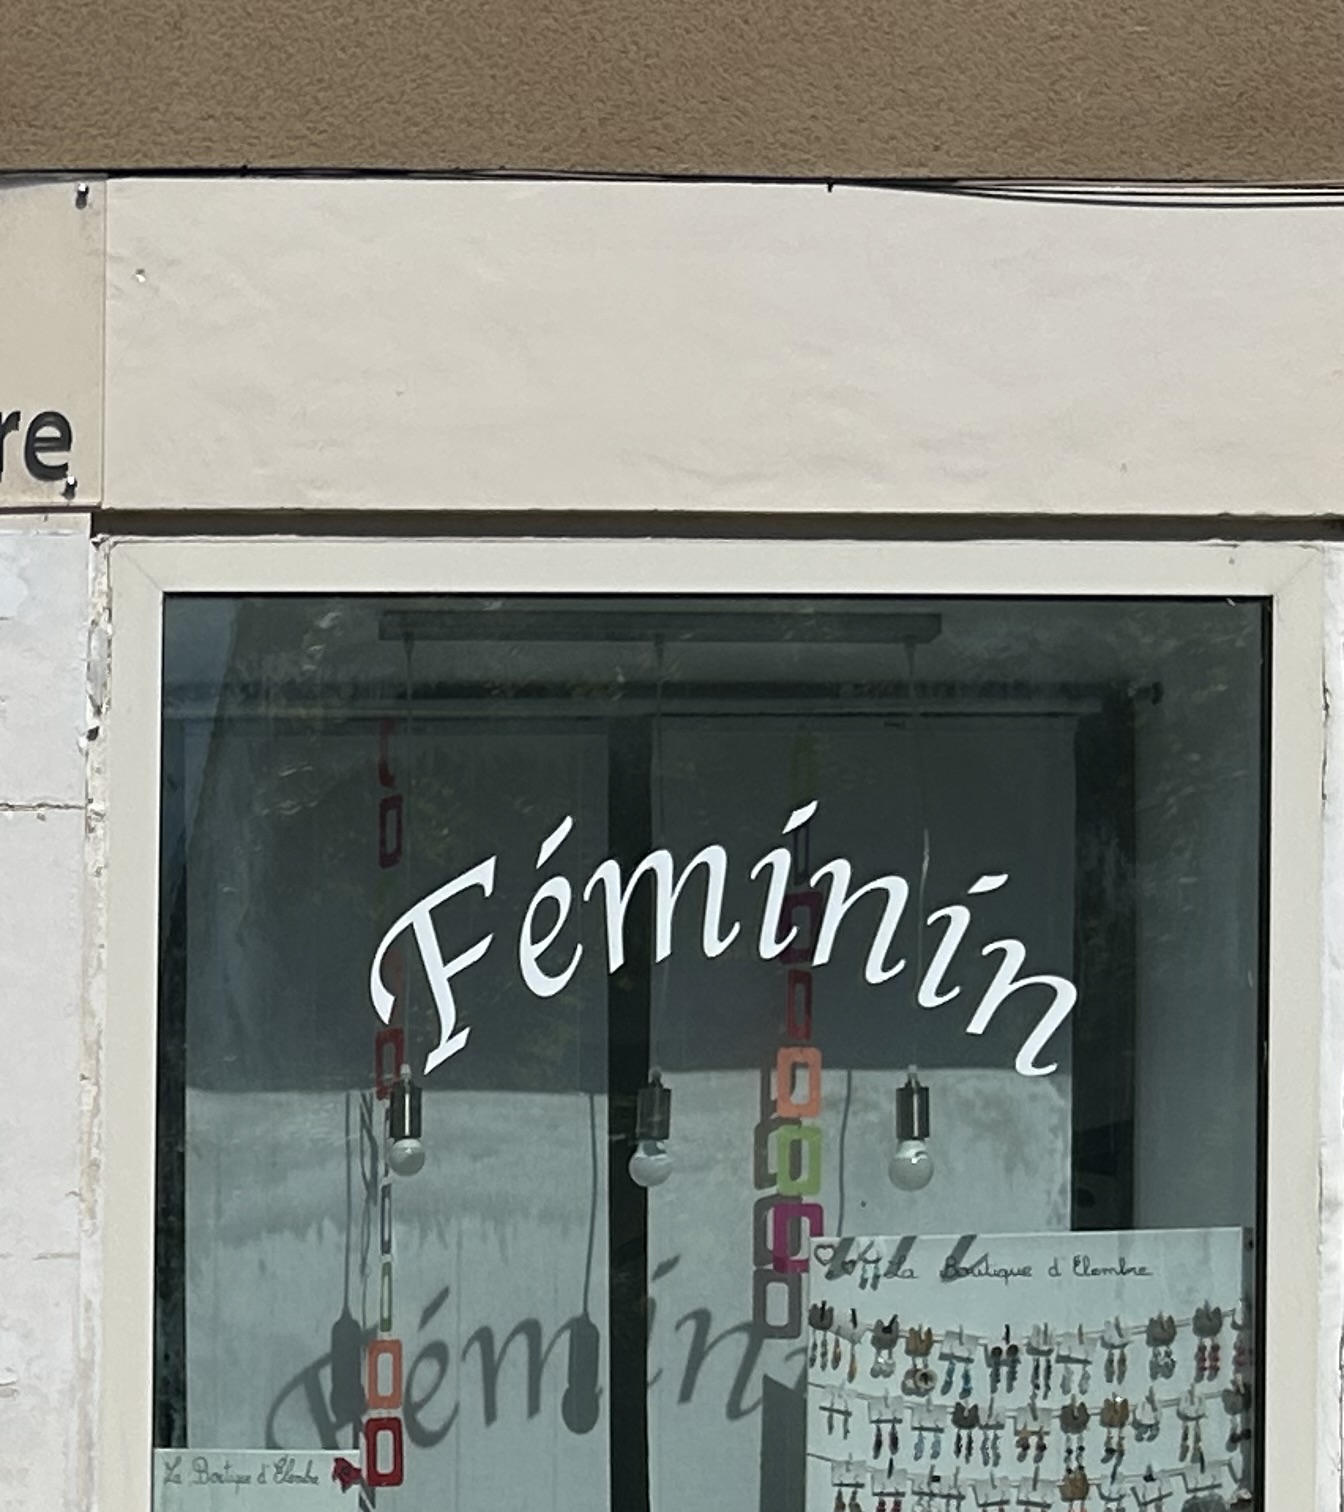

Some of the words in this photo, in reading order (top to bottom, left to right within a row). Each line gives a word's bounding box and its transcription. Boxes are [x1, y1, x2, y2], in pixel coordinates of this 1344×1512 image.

[369, 801, 1078, 1076] Féminin
[883, 1255, 918, 1280] La
[939, 1253, 1033, 1286] Boutique
[163, 1455, 182, 1485] La
